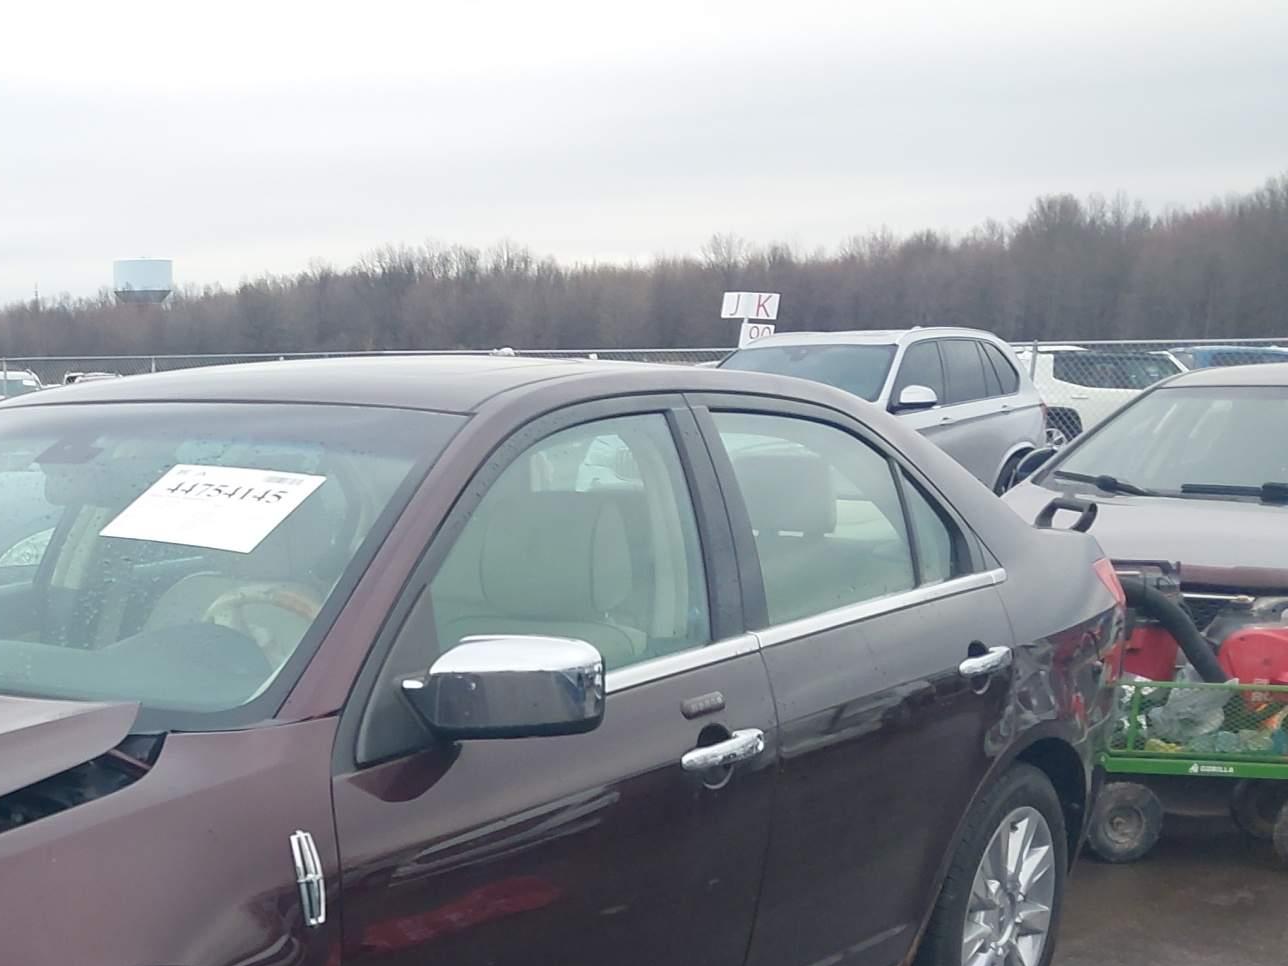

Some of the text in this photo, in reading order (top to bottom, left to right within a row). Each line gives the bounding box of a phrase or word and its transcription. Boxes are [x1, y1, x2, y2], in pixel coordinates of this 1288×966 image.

[729, 293, 773, 318] J K
[167, 481, 289, 503] 44754145
